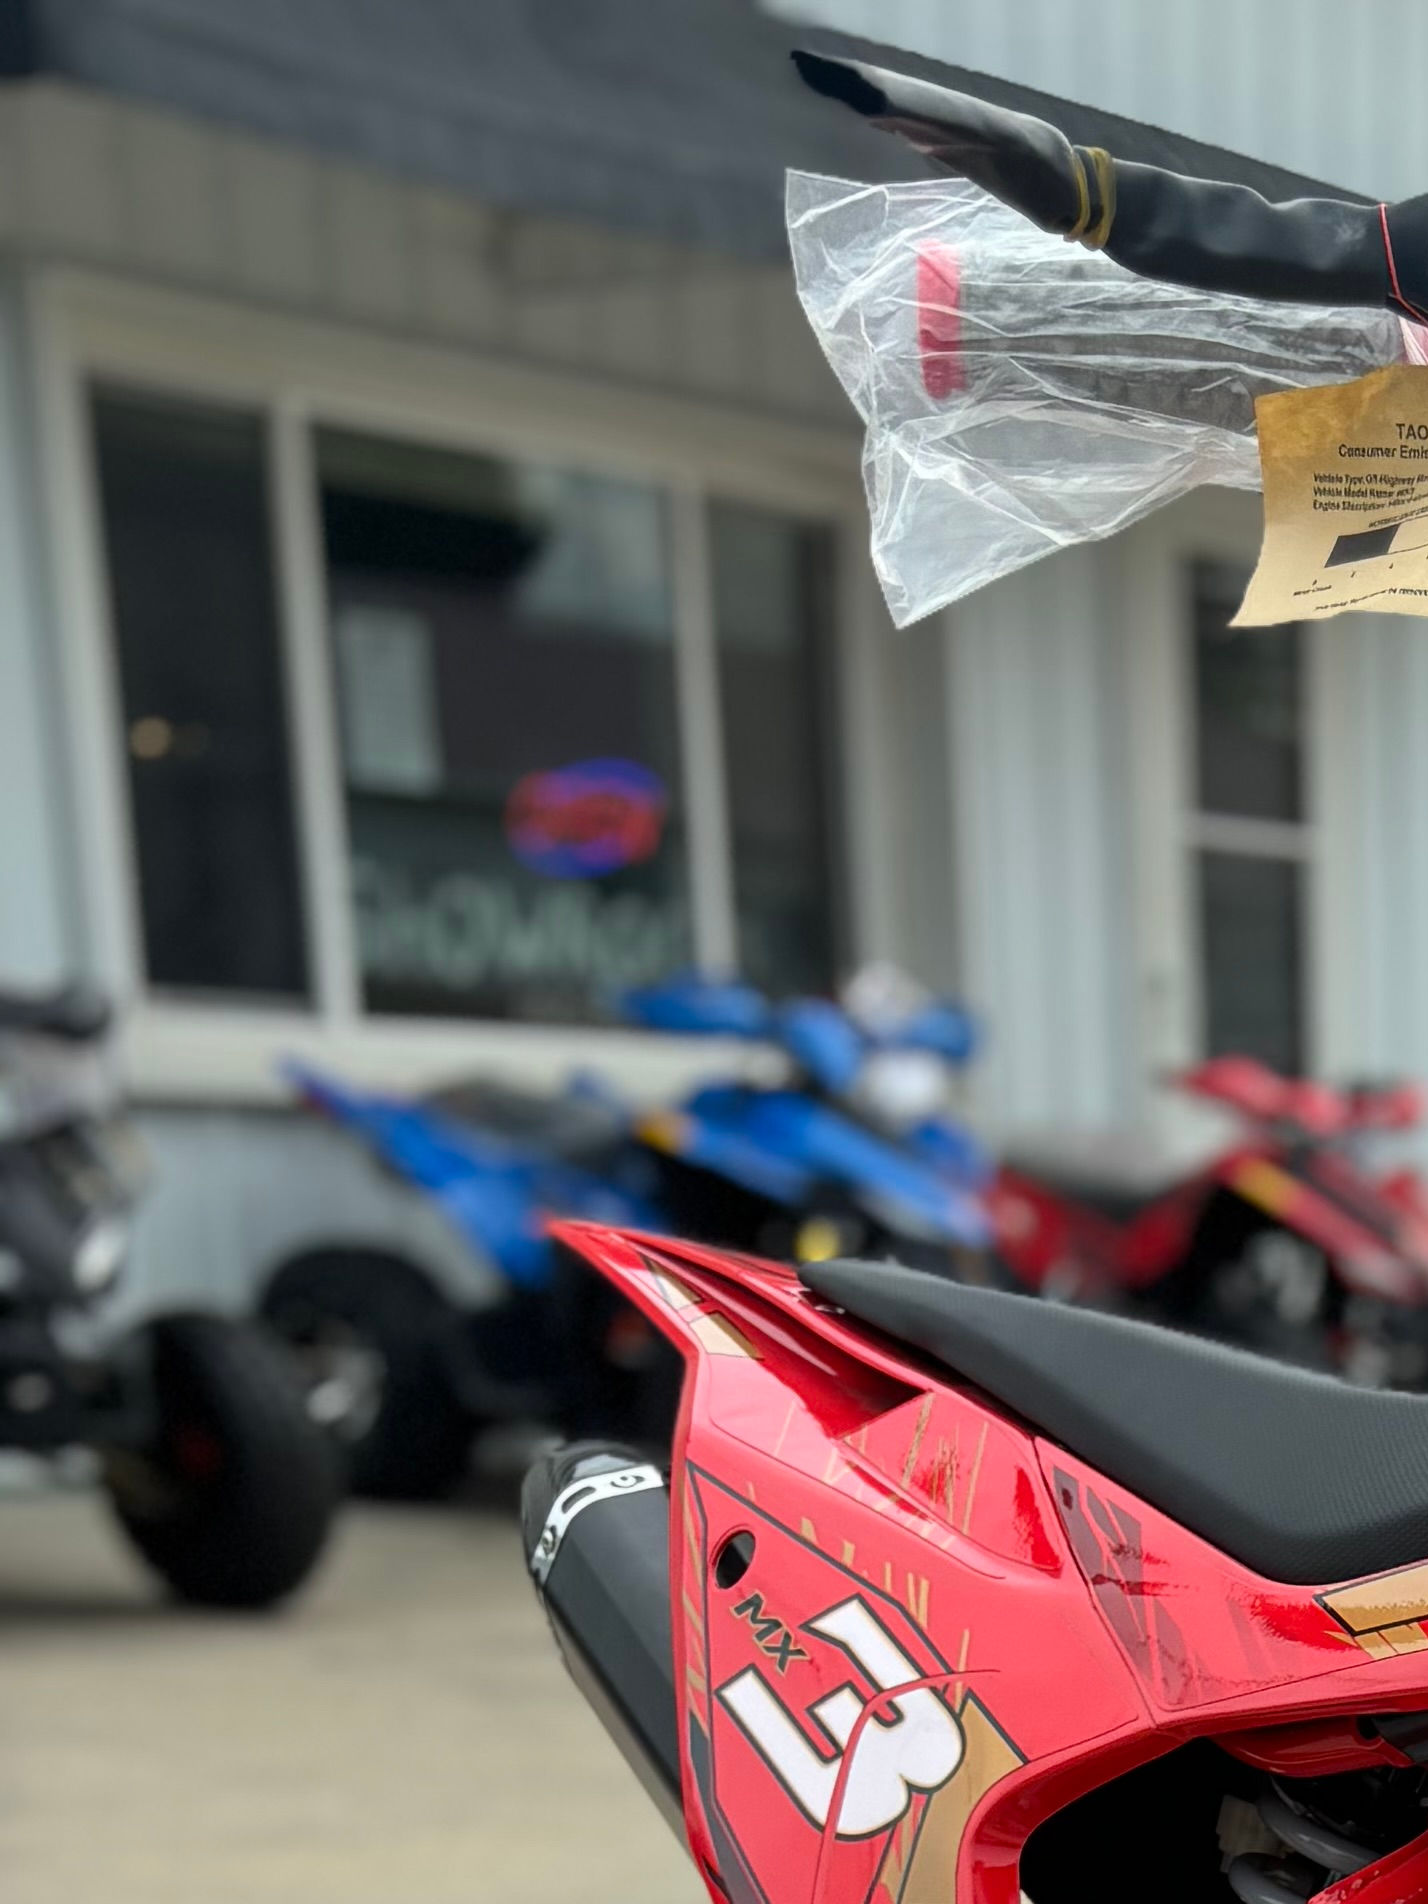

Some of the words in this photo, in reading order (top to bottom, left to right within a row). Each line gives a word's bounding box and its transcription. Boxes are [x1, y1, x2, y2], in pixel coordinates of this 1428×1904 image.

[1339, 444, 1397, 458] Consumer
[1396, 423, 1428, 440] TAO
[731, 1594, 808, 1674] MX
[717, 1594, 967, 1841] 3
